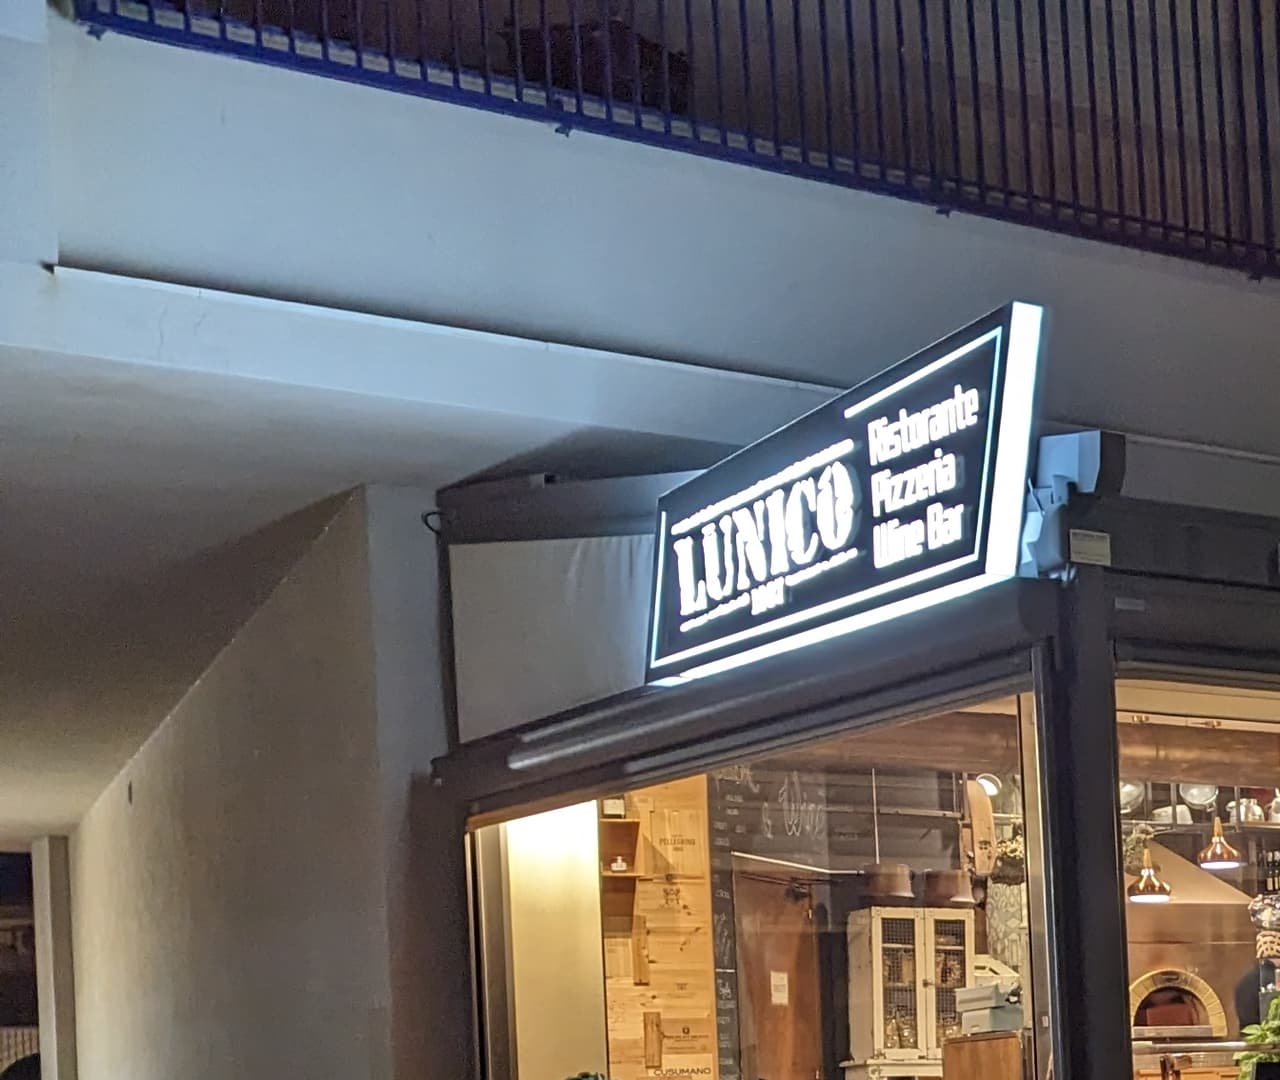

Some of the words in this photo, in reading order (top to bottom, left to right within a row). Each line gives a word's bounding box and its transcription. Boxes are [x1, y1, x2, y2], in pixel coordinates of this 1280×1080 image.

[867, 384, 979, 465] Ristorante
[871, 449, 956, 517] Pizzeria
[674, 462, 855, 615] LUNICO
[873, 520, 923, 568] Wine
[927, 503, 964, 551] Bar
[653, 1067, 712, 1077] CUSUMANO
